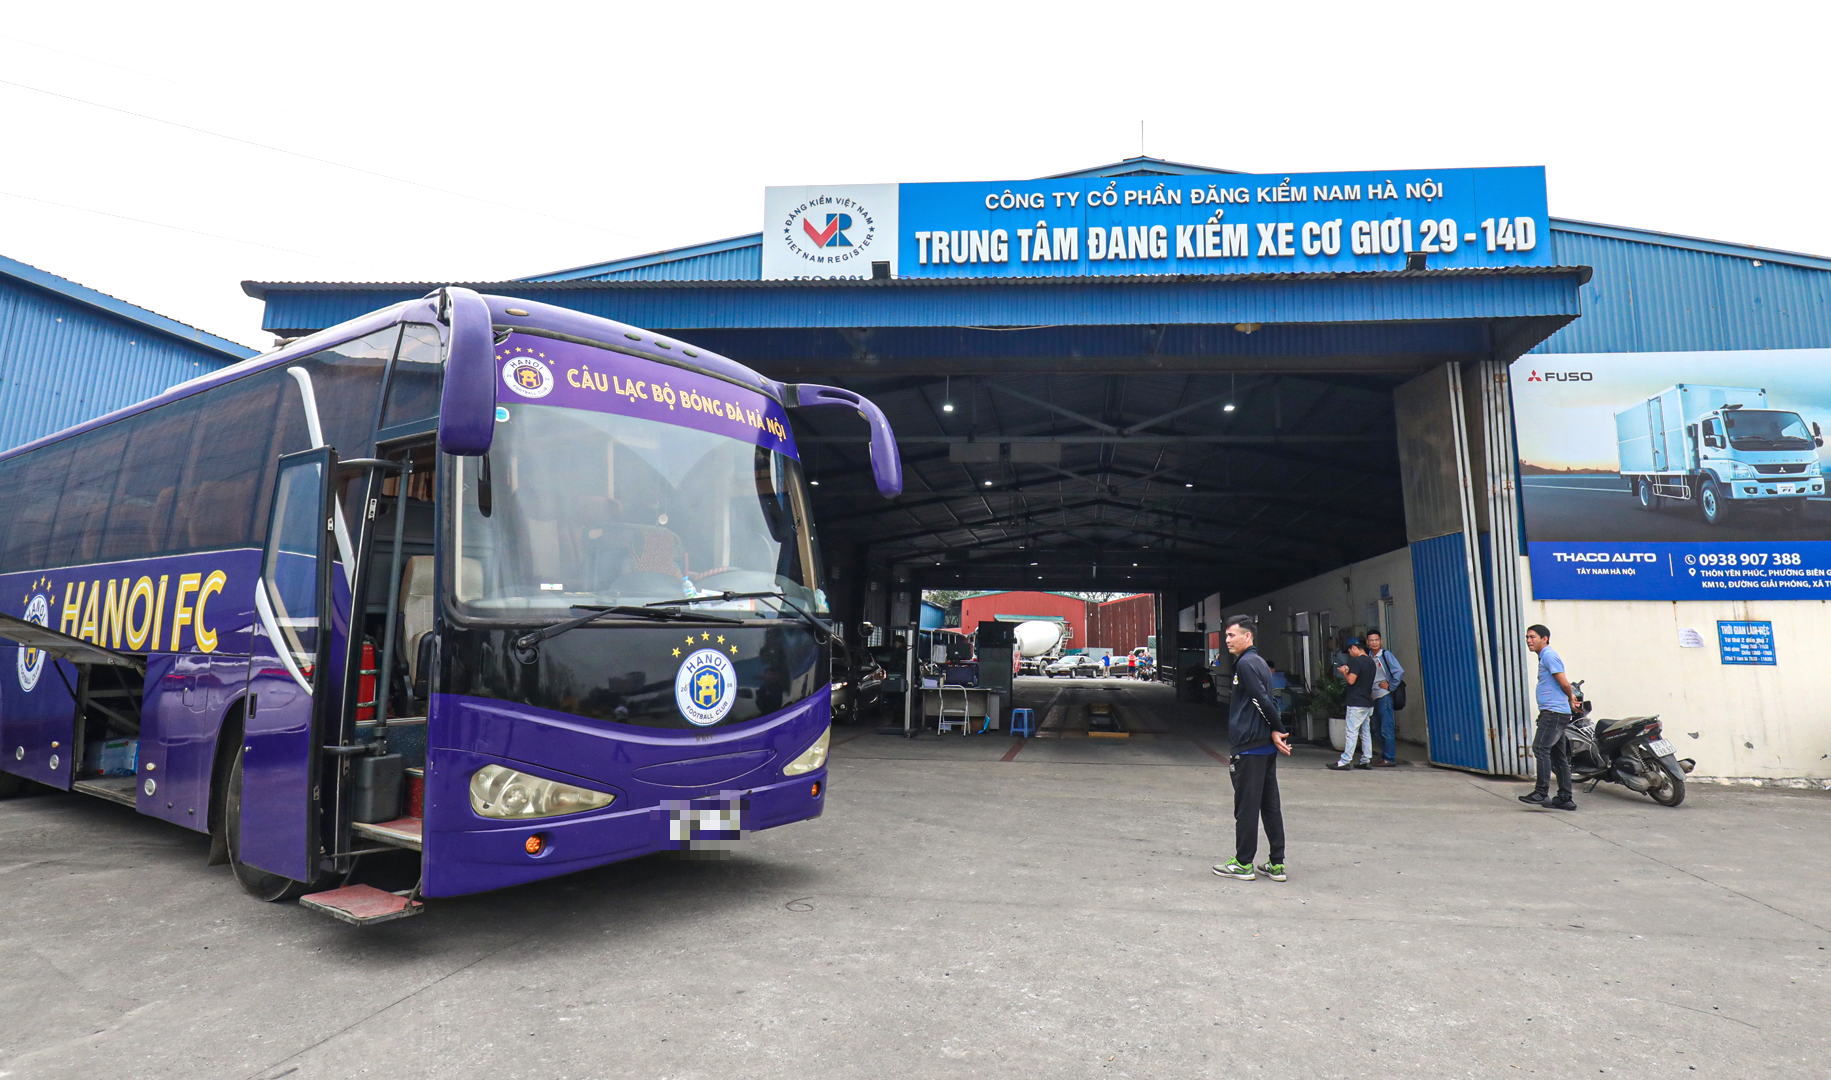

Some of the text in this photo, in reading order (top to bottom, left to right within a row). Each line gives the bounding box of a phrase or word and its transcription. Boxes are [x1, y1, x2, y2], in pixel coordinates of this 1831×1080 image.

[985, 177, 1443, 209] CÔNG TY CỔ PHẦN ĐĂNG KIỂM NAM HÀ NỘI
[835, 196, 857, 209] VIỆT
[856, 206, 874, 225] NAM
[915, 227, 1009, 265] TRUNG
[1017, 219, 1079, 263] TÂM
[1176, 208, 1249, 259] KIỂM
[1256, 221, 1295, 258] XE
[1301, 218, 1343, 257] CƠ
[1420, 218, 1458, 254] 29
[1481, 216, 1537, 252] 14D
[827, 233, 874, 264] REGISTER
[509, 359, 543, 371] HANOI
[1544, 372, 1593, 382] FUSO
[566, 364, 787, 442] CÂU LẠC BỘ BÓNG ĐÁ HÀ NỘI
[1553, 552, 1657, 562] THACO AUTO
[1699, 552, 1801, 566] 0938 907 388
[1576, 567, 1591, 575] TÂY
[1610, 567, 1621, 575] HÀ
[1622, 567, 1636, 576] NỘI
[1700, 568, 1724, 577] THÔN
[1725, 568, 1741, 577] YÊN
[1768, 568, 1805, 577] PHƯỜNG
[1806, 567, 1825, 576] BIÊN
[1702, 581, 1727, 589] KM10,
[1728, 580, 1760, 588] ĐƯỜNG
[1760, 579, 1778, 588] GIẢI
[1779, 579, 1812, 588] PHÓNG,
[60, 569, 227, 653] HANOI FC
[686, 653, 727, 673] HANOI
[686, 701, 729, 720] FOOTBALL CLUB
